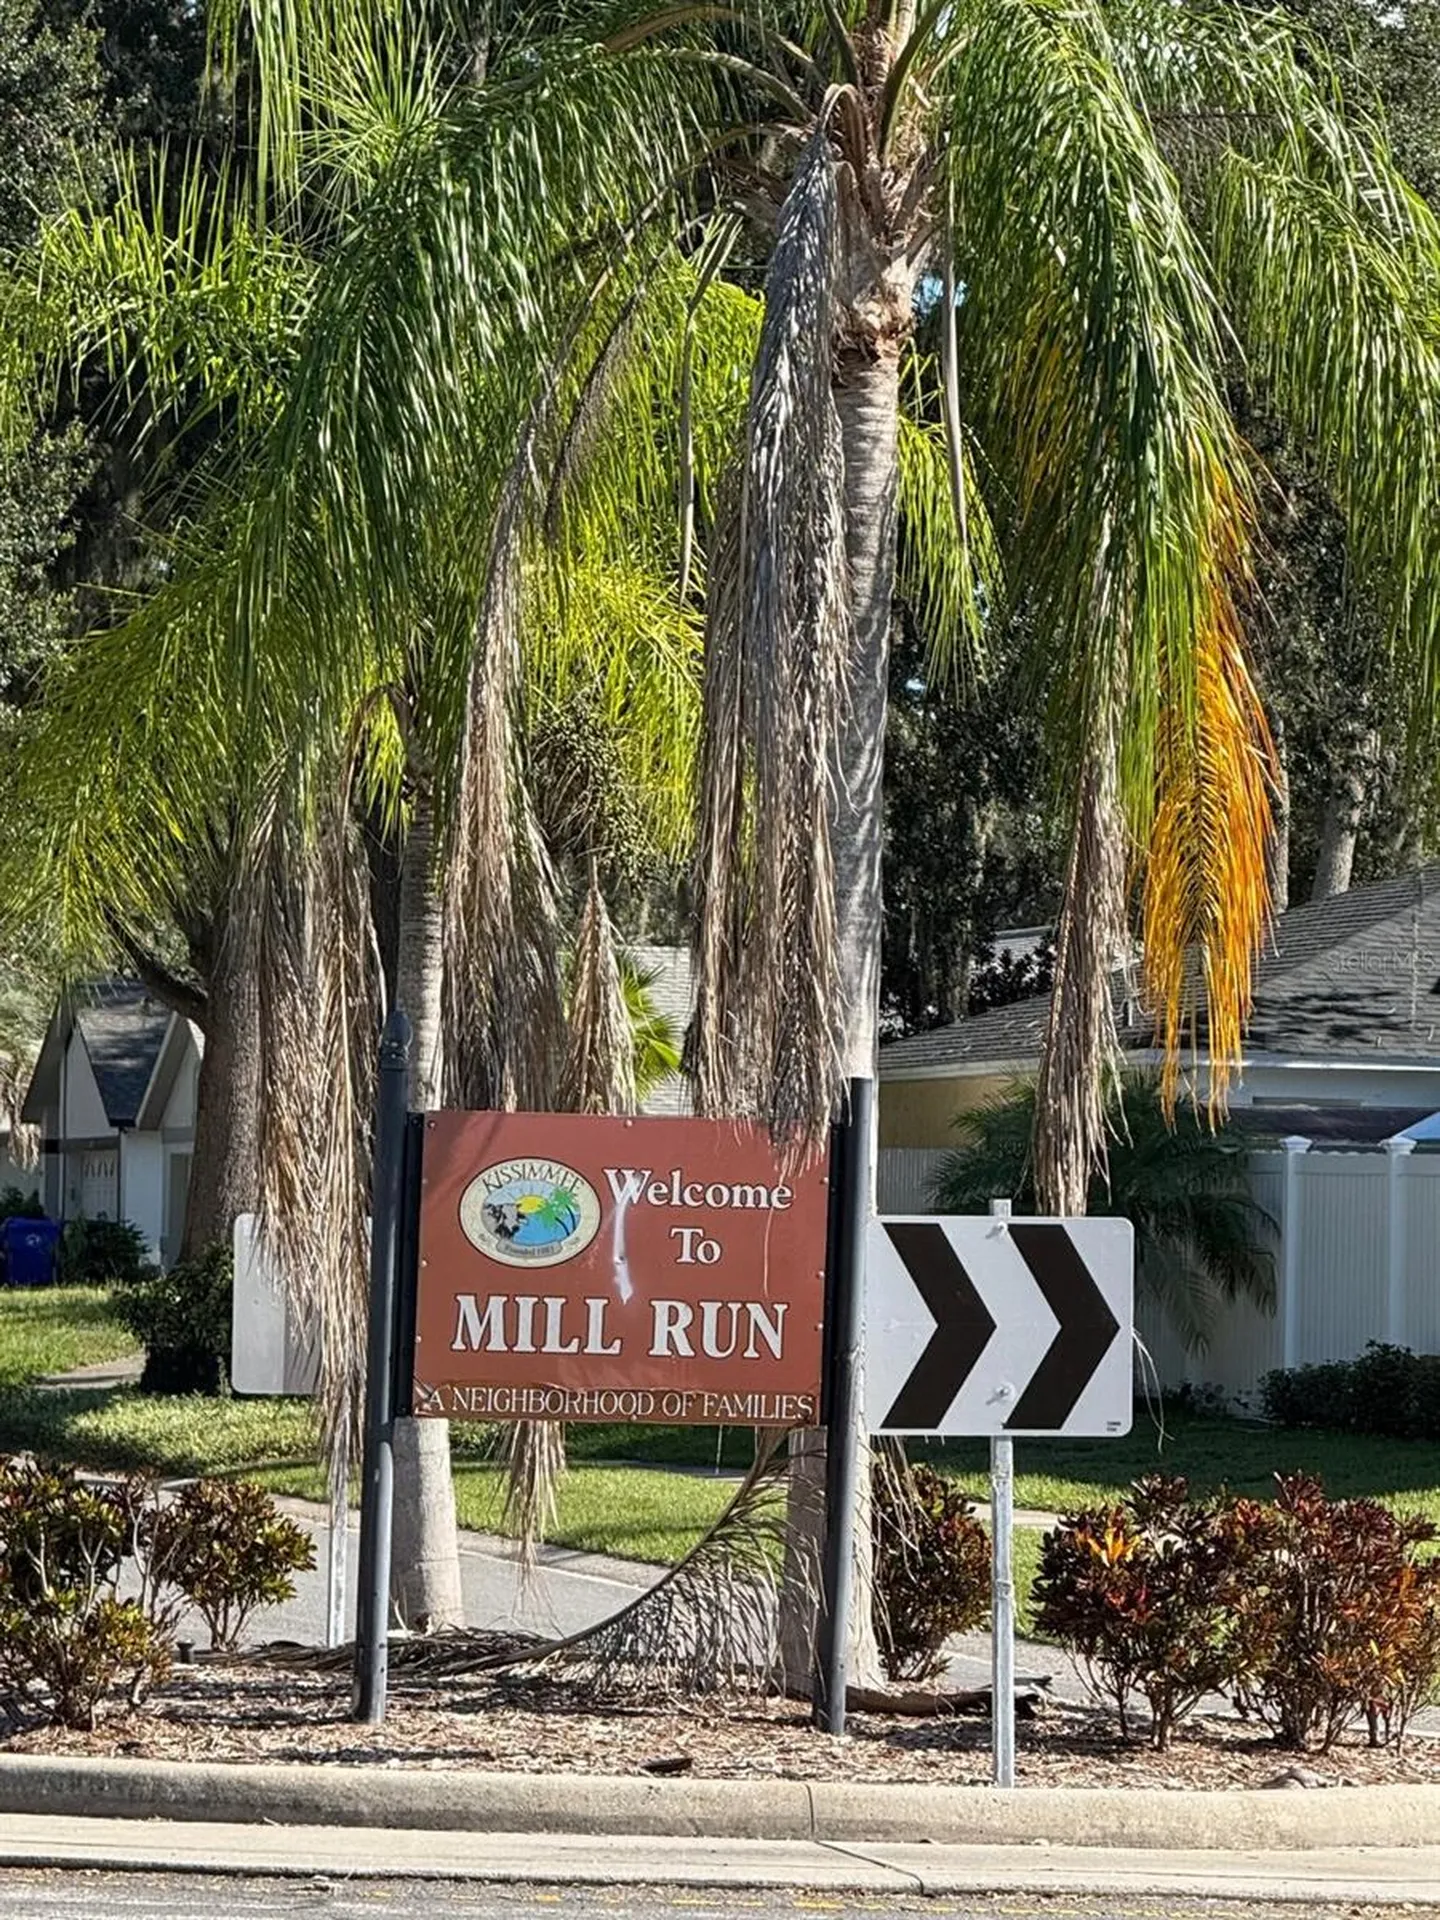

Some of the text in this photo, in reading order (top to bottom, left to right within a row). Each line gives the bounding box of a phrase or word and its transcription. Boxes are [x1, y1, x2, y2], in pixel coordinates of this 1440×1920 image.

[482, 1163, 585, 1195] KISSIMMEE
[603, 1168, 792, 1209] Welcome
[670, 1227, 722, 1264] To
[451, 1294, 788, 1360] MILL RUN
[428, 1387, 813, 1420] A NEIGHBORHOOD OF FAMILIES
